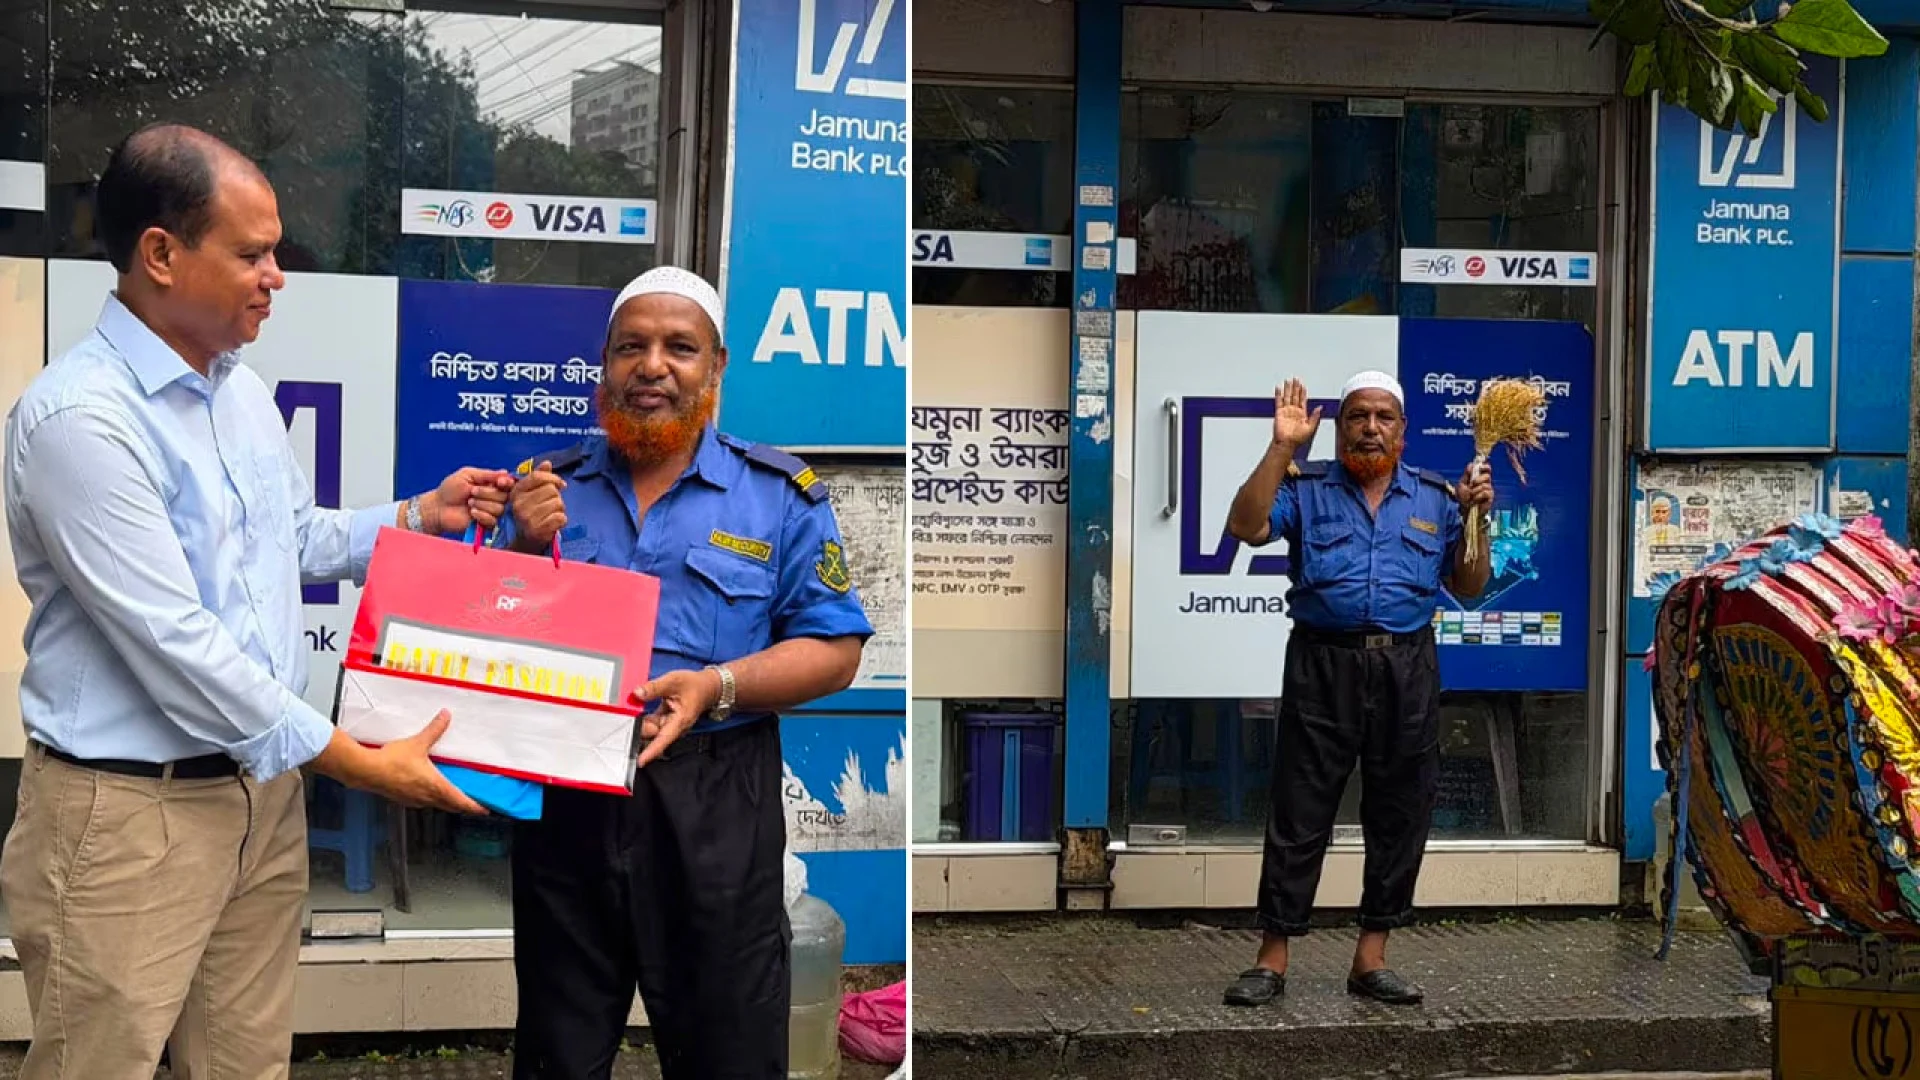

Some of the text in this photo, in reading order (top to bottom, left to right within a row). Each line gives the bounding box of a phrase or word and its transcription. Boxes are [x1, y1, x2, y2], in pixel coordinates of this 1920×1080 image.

[791, 142, 865, 174] Bank
[525, 203, 606, 234] VISA
[1702, 198, 1790, 221] Jamuna
[912, 233, 954, 261] SA
[1697, 223, 1794, 246] Bank PLC.
[1496, 256, 1558, 279] VISA
[430, 351, 604, 385] নিশ্চিত প্রবাস জীব
[1672, 329, 1814, 388] ATM
[1423, 372, 1477, 397] নিশ্চিত
[457, 387, 589, 419] সমৃদ্ধ ভবিষ্যত
[990, 408, 1070, 437] ব্যাংক
[959, 443, 980, 468] ও
[1179, 591, 1284, 613] Jamuna
[304, 624, 337, 652] nk
